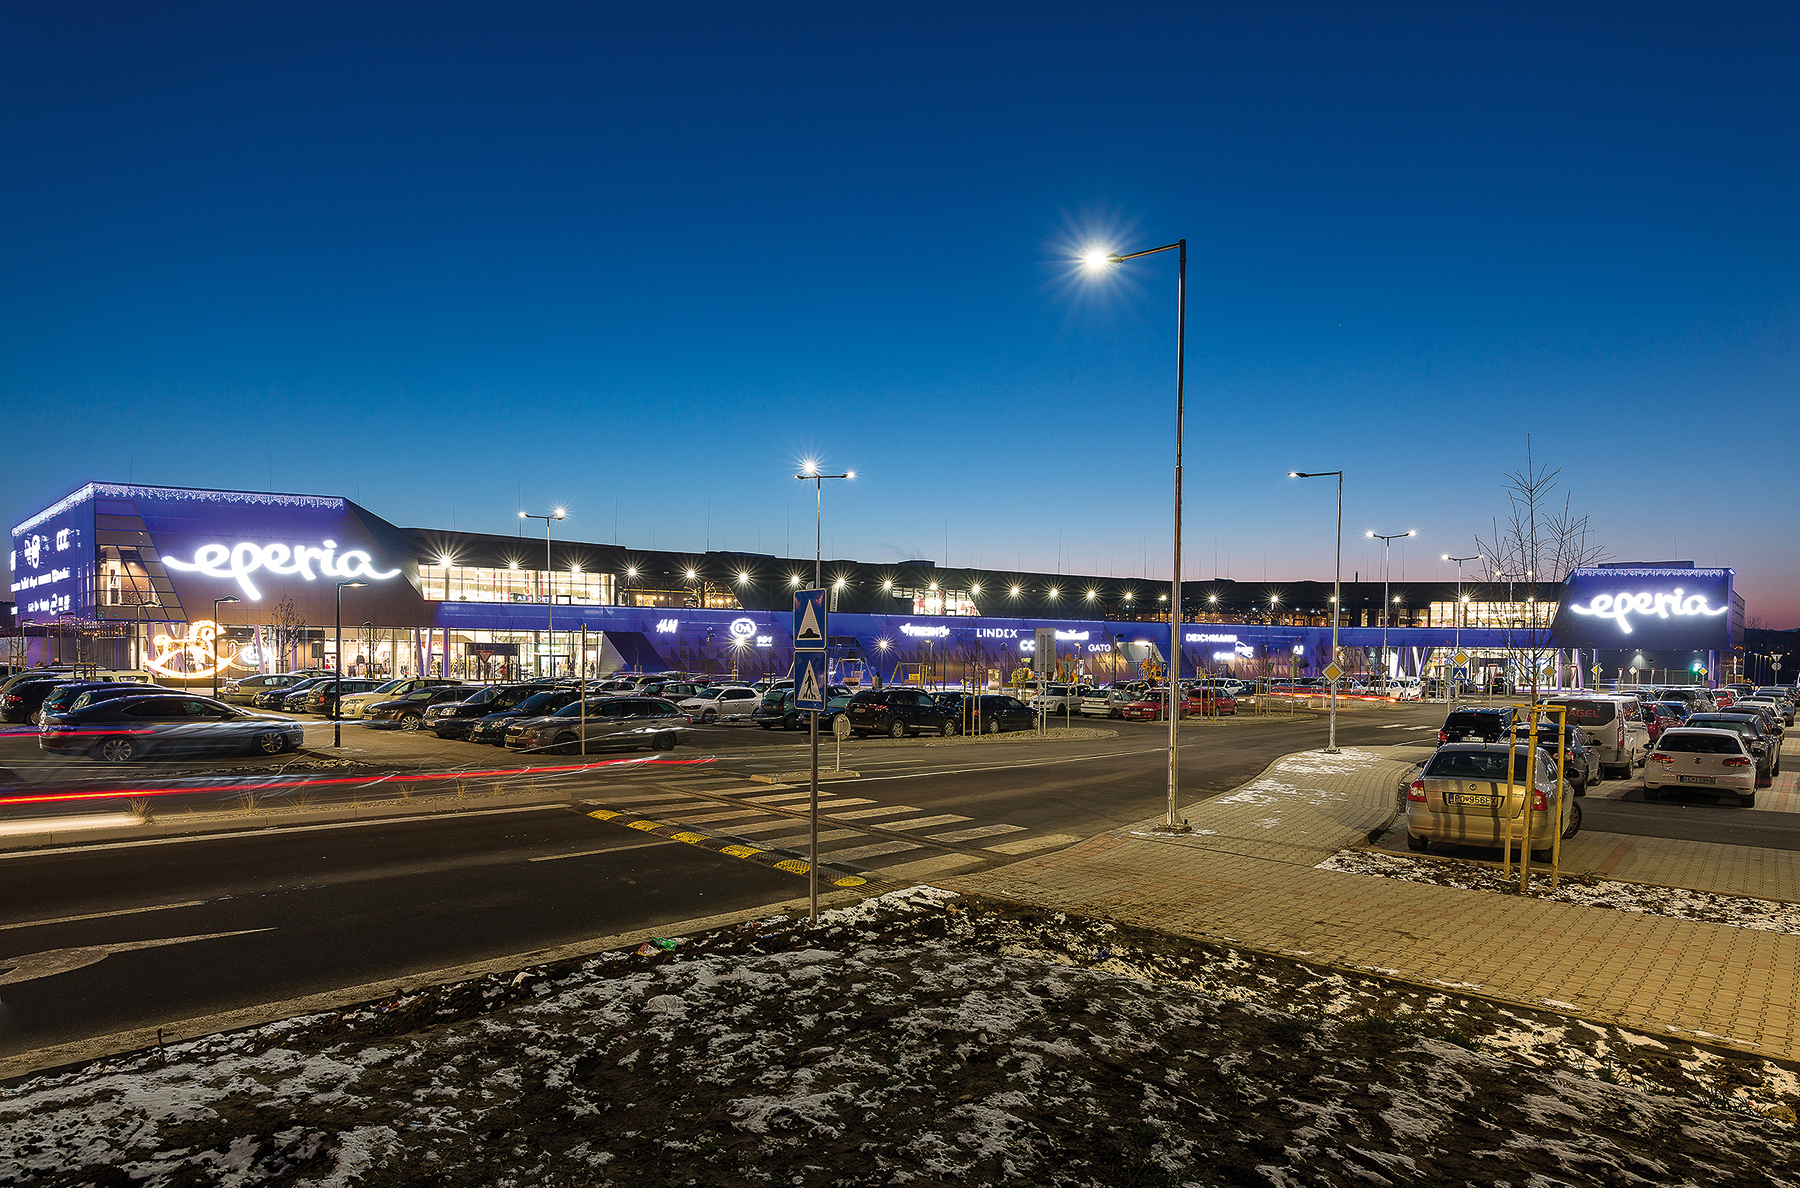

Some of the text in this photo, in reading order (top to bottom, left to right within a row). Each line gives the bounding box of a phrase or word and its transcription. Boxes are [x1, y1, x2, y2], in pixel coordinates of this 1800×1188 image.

[160, 539, 402, 601] eperia
[1570, 588, 1729, 634] eperia
[976, 628, 1019, 639] LINDEX
[1185, 633, 1238, 643] DEICHMANN
